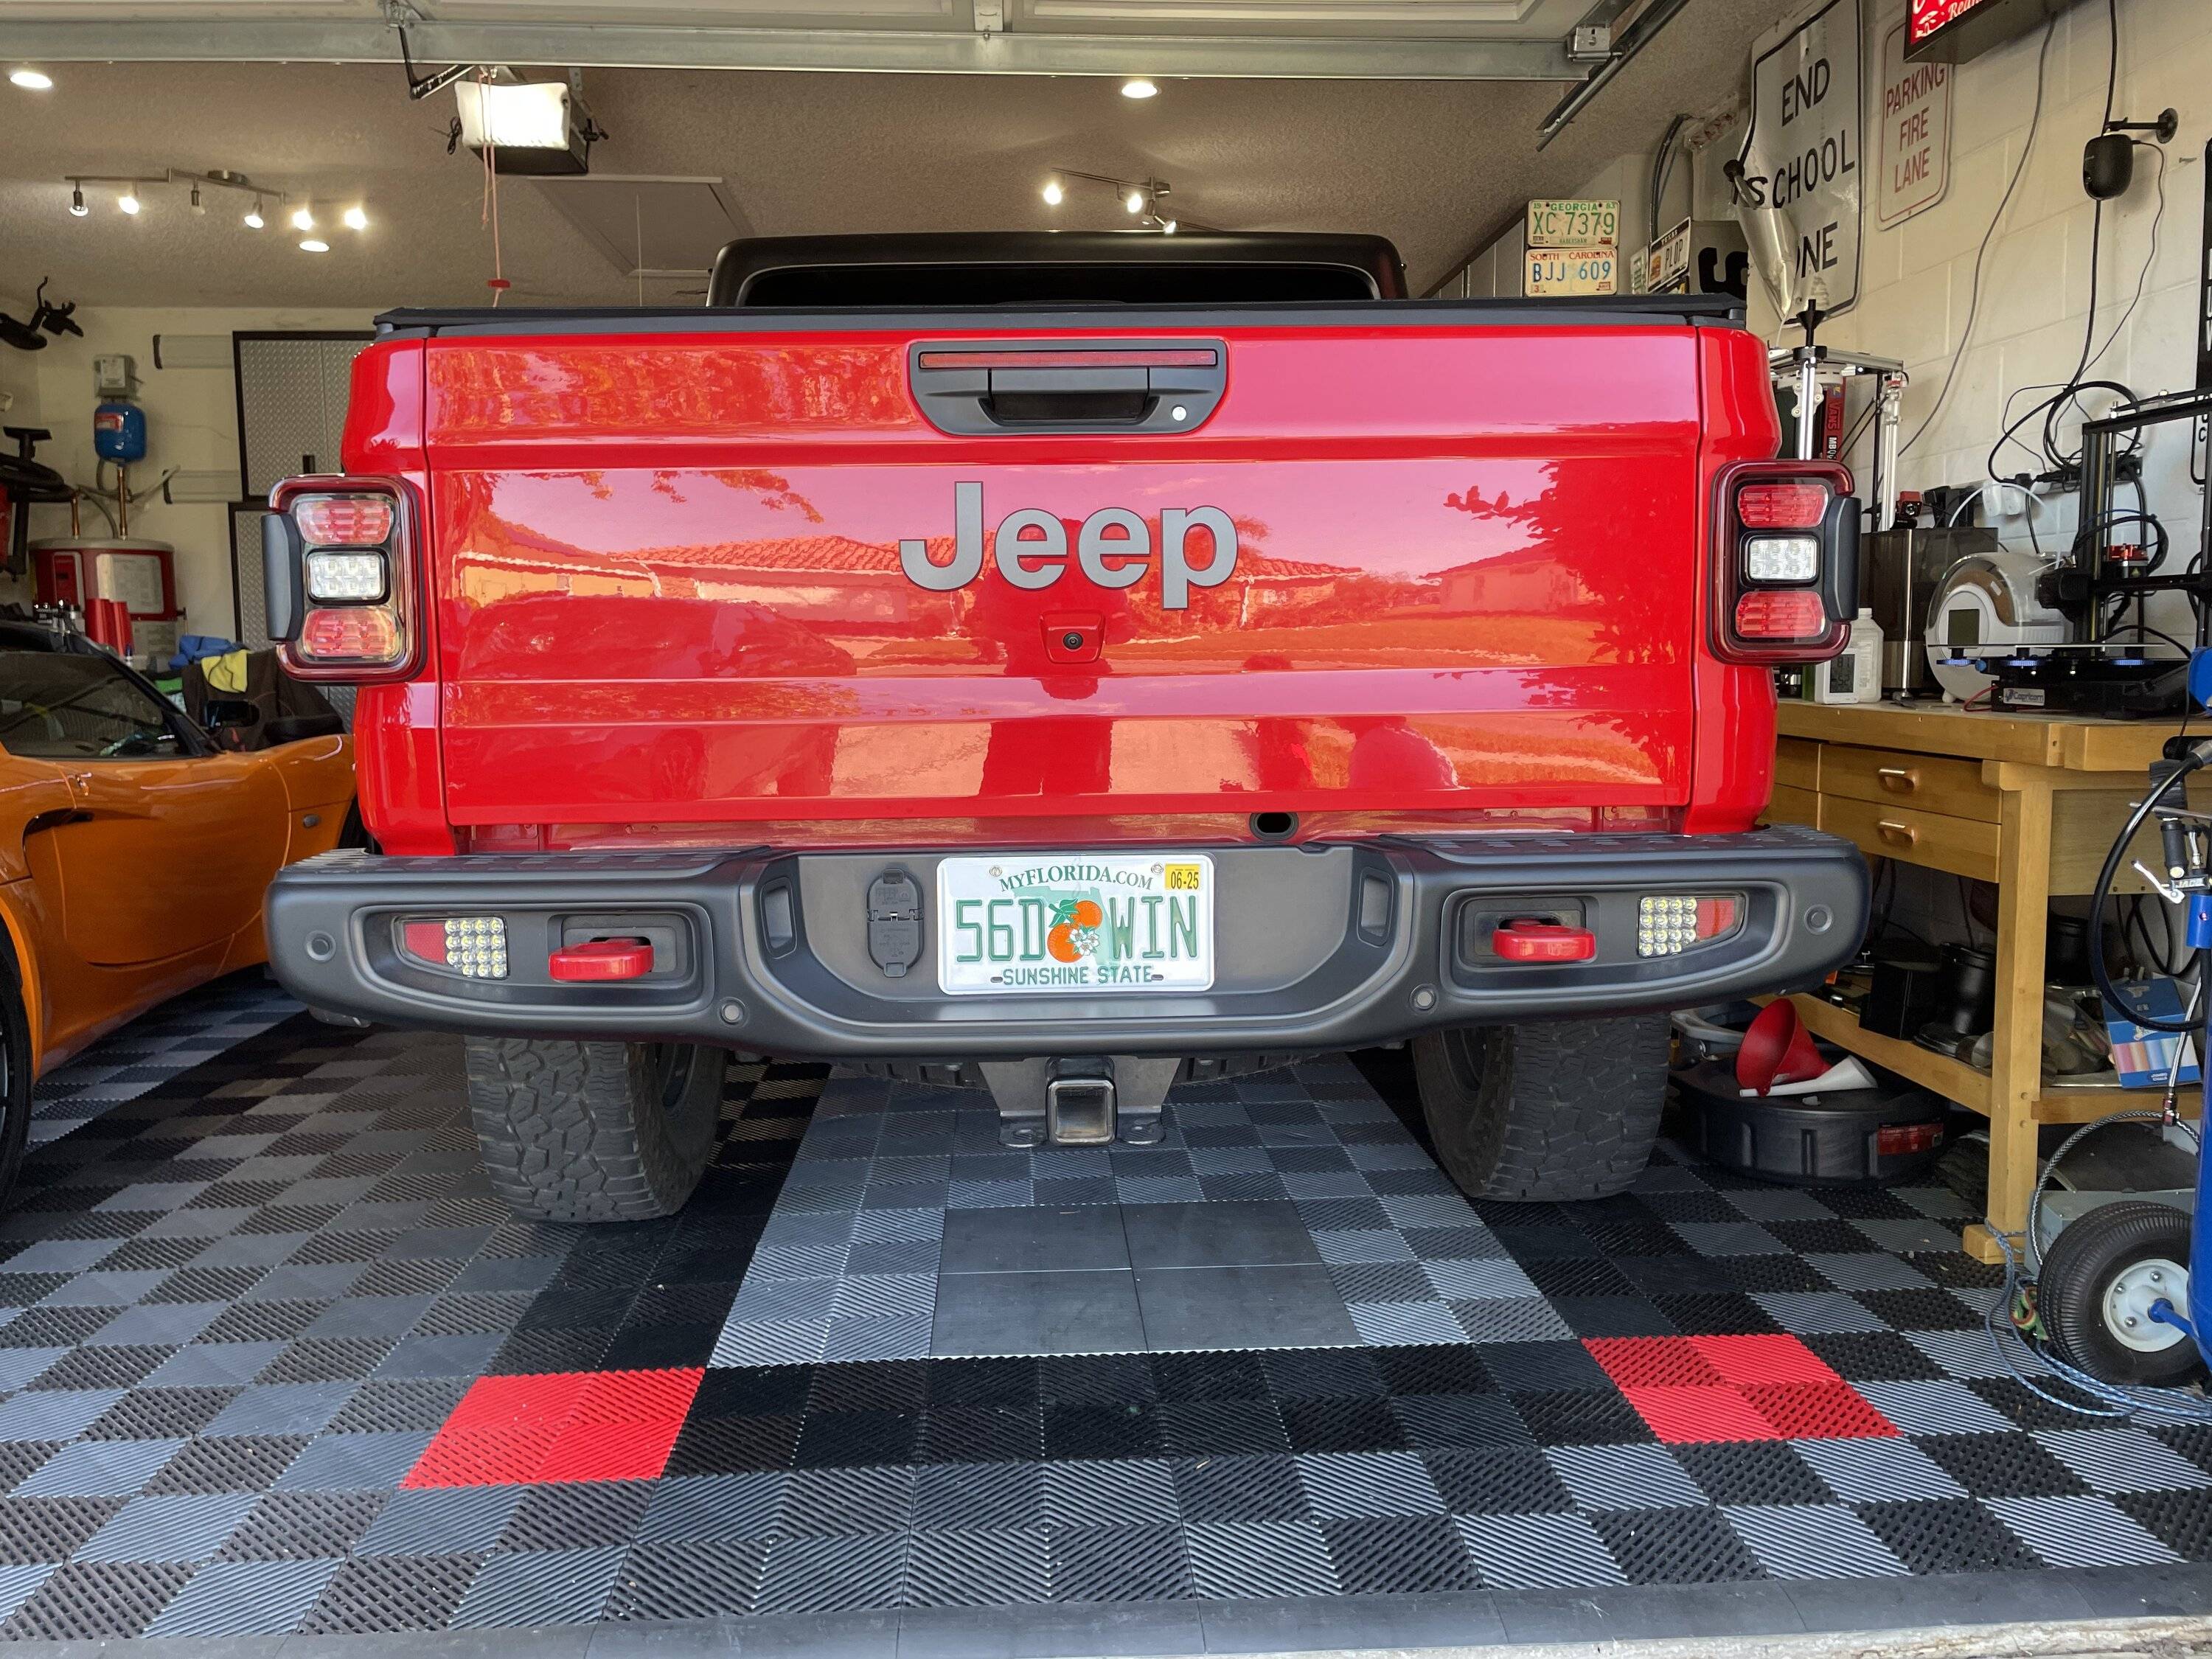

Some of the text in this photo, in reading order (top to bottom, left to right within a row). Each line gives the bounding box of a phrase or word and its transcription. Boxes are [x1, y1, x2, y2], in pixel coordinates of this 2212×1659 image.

[1782, 58, 1830, 127] END
[1885, 63, 1945, 119] PARKING
[1900, 106, 1930, 151] FIRE
[1745, 130, 1855, 209] SCHOOL
[1894, 147, 1931, 193] LANE
[1533, 212, 1615, 235] XC 7379
[1551, 203, 1599, 211] GEORGIA
[1529, 251, 1615, 261] SOUTH CAROLINA
[1665, 239, 1683, 271] PLOP
[1795, 221, 1838, 278] NE
[1533, 262, 1565, 282] BJJ
[1579, 260, 1611, 280] 609
[1828, 400, 1841, 431] VANS
[898, 481, 1239, 611] Jeep
[1000, 865, 1153, 892] MYFLORIDA.COM
[956, 895, 1197, 962] 56D WIN
[1003, 965, 1152, 986] SUNSHINE STATE
